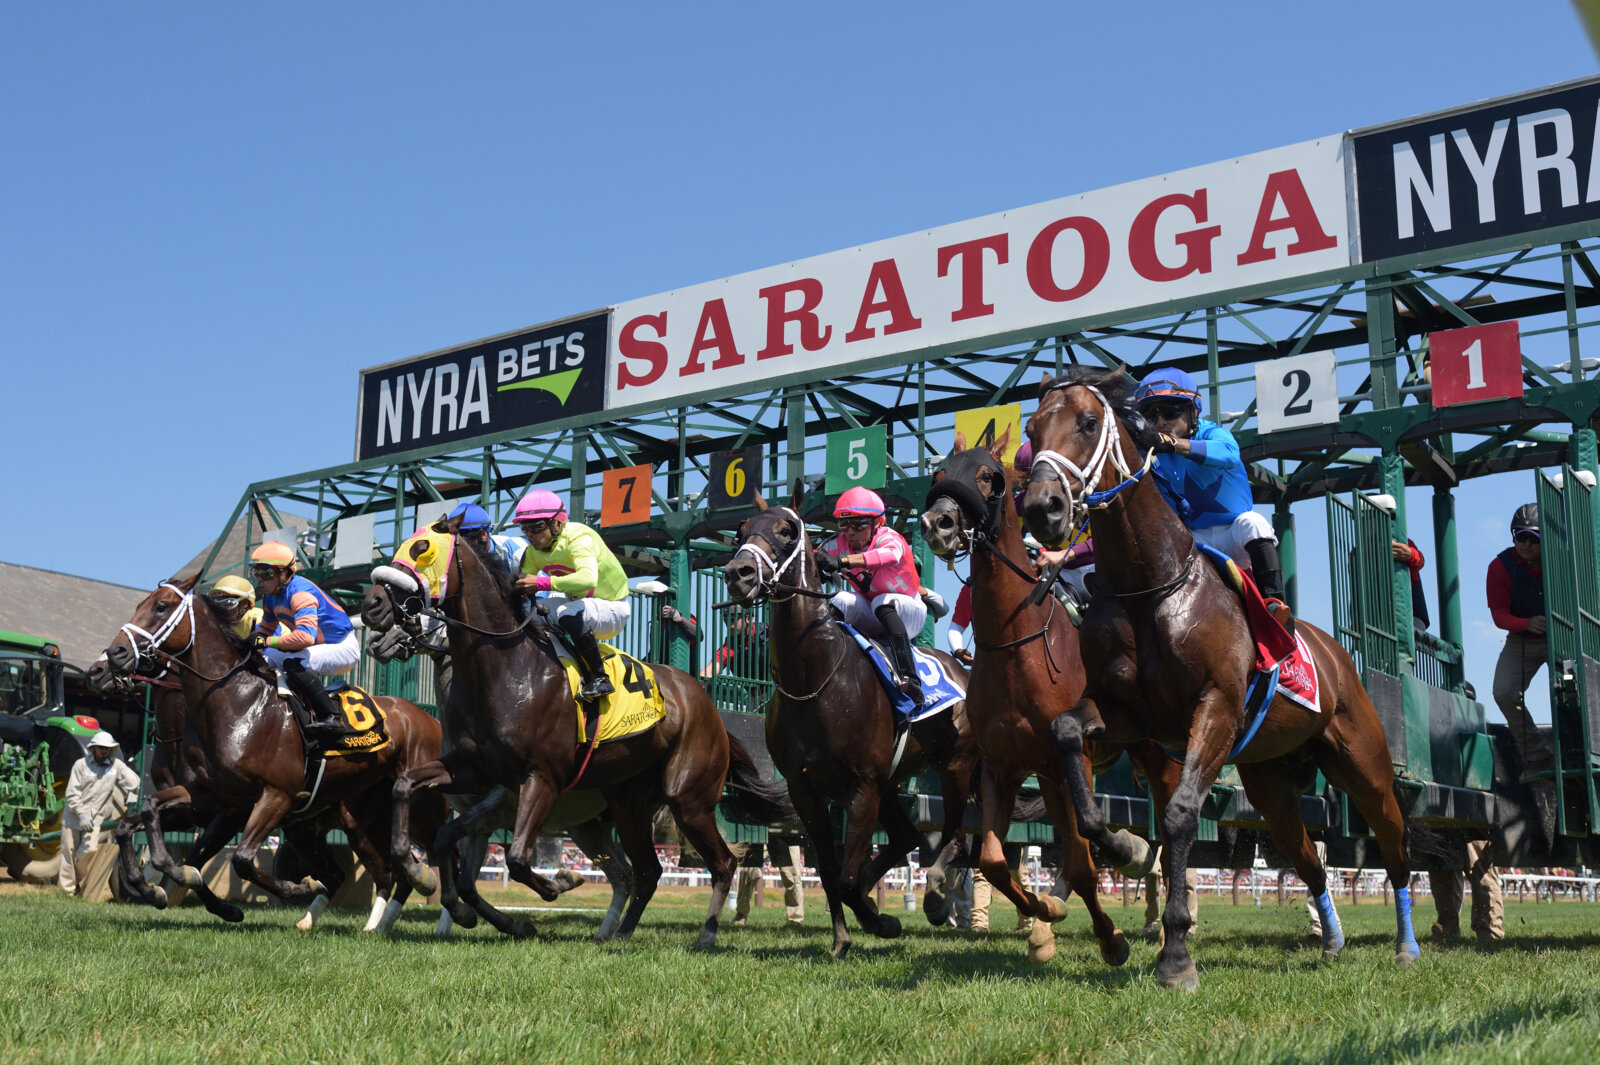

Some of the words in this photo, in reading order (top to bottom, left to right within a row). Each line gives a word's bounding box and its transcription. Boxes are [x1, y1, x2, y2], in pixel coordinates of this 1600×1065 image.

[1392, 98, 1600, 240] NYR
[617, 168, 1337, 390] SARATOGA
[1461, 338, 1487, 390] 1
[376, 355, 491, 447] NYRA
[497, 331, 585, 384] BETS
[1282, 369, 1313, 417] 2
[725, 457, 746, 498] 6
[846, 438, 869, 480] 5
[618, 476, 637, 514] 7
[619, 653, 654, 700] 4
[338, 690, 376, 731] 6
